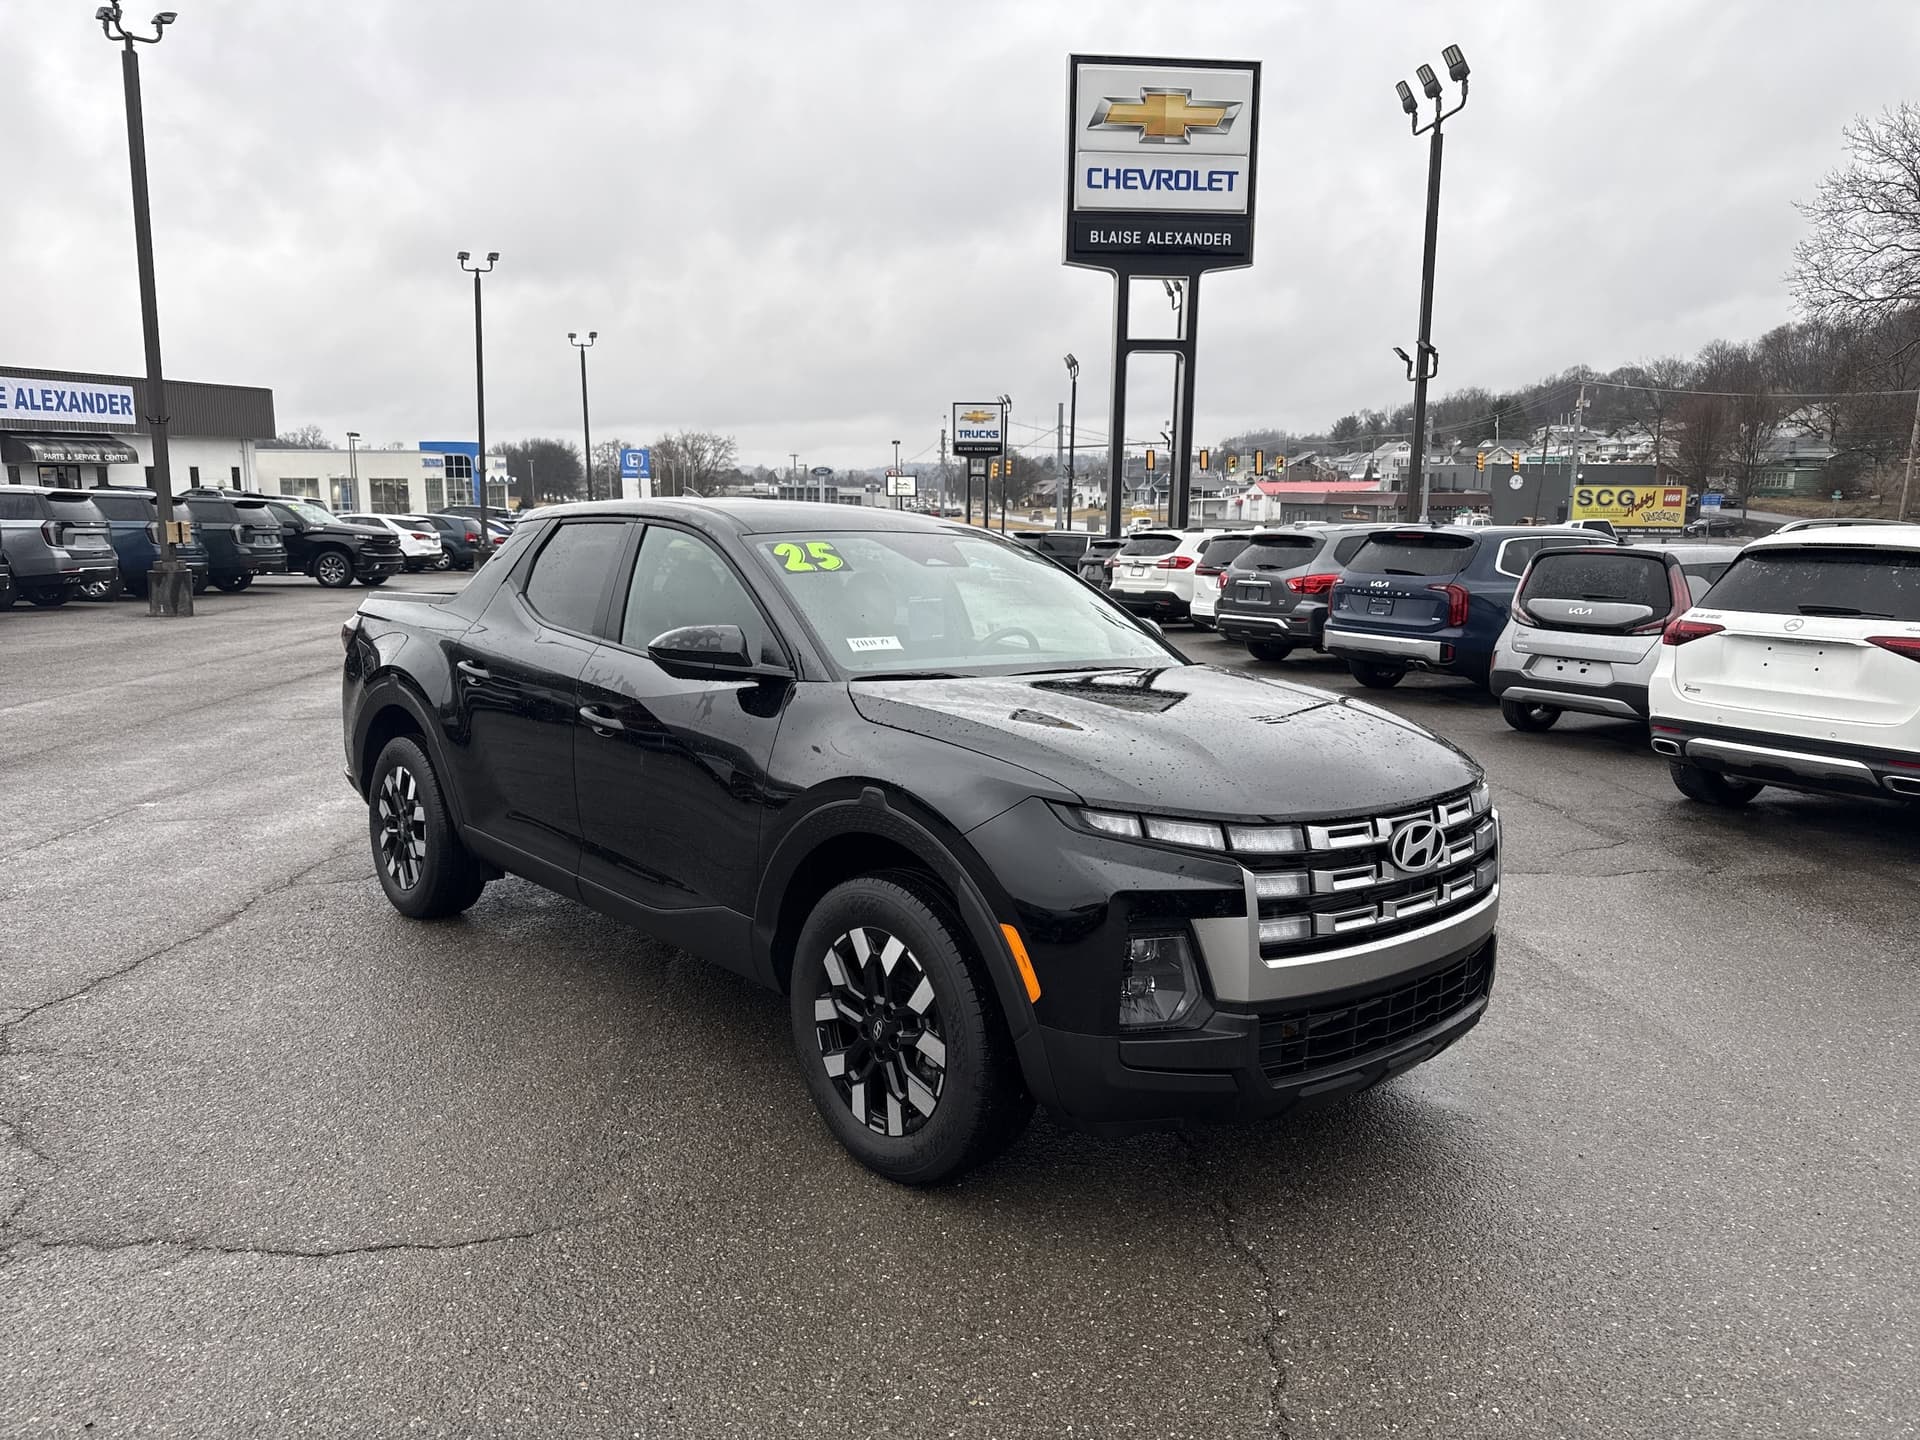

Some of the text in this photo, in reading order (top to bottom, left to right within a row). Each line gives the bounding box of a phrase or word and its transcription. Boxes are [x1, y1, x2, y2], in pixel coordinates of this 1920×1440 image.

[1087, 168, 1239, 191] CHEVROLET
[1090, 231, 1232, 246] BLAISE ALEXANDER
[15, 388, 133, 415] ALEXANDER
[958, 430, 999, 438] TRUCKS
[74, 453, 101, 461] SERVICE
[1577, 489, 1636, 507] SCG
[1624, 490, 1656, 517] Hobby
[773, 543, 843, 571] 25
